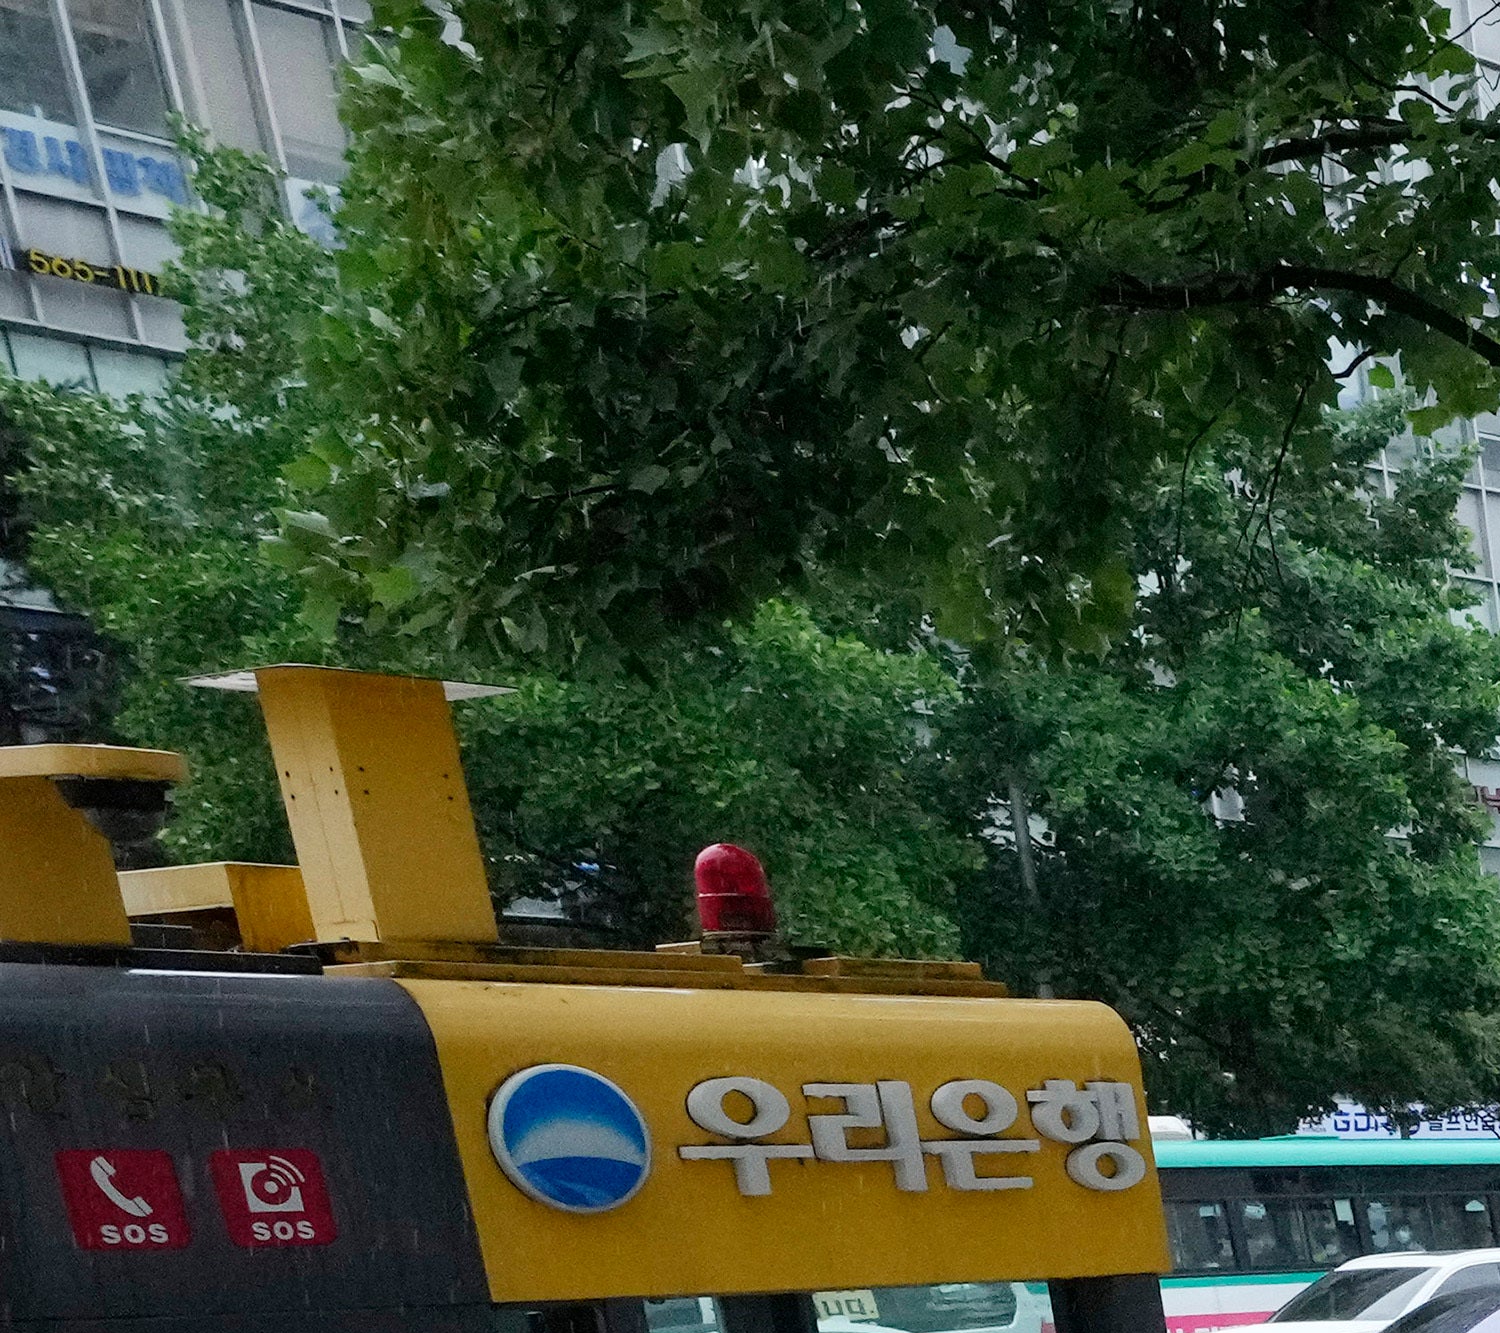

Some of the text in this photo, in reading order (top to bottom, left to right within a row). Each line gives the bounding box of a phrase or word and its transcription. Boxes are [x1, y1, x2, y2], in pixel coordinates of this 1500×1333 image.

[678, 1076, 1146, 1196] 우리은행
[101, 1224, 169, 1244] SOS
[251, 1221, 315, 1241] SOS
